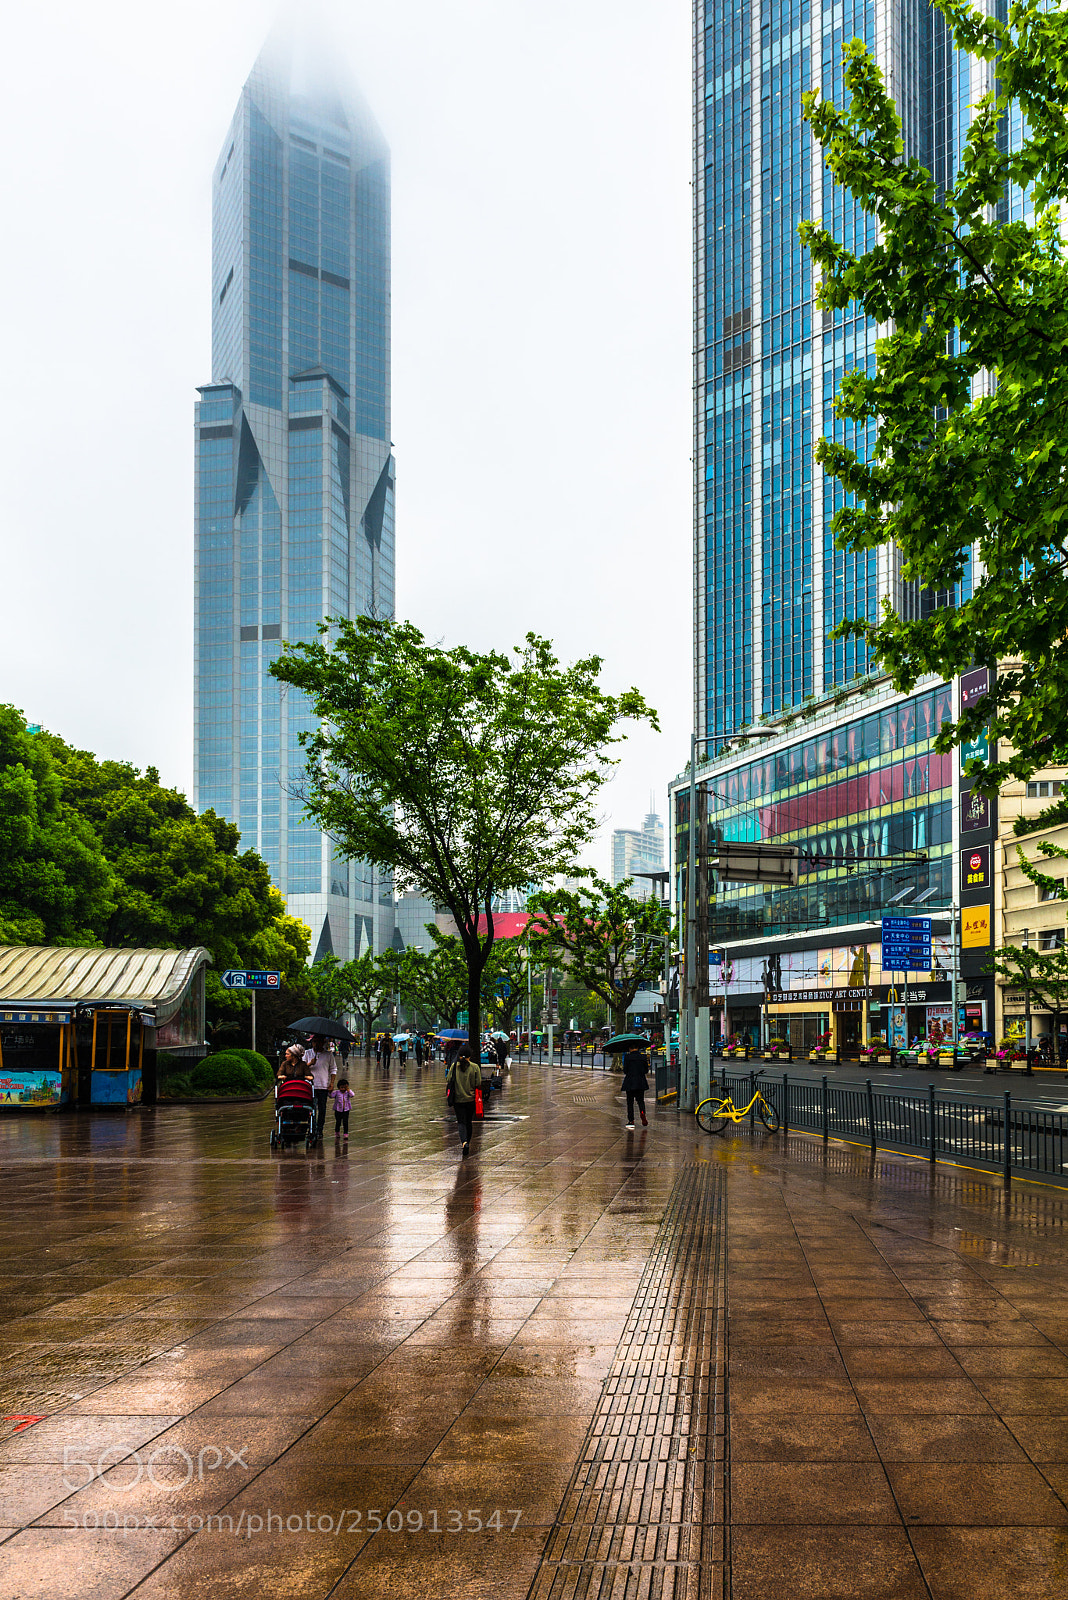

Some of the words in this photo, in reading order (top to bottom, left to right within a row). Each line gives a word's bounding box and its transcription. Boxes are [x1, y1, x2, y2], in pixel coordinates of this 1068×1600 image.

[835, 990, 847, 999] ART
[900, 990, 927, 1002] 麦当劳
